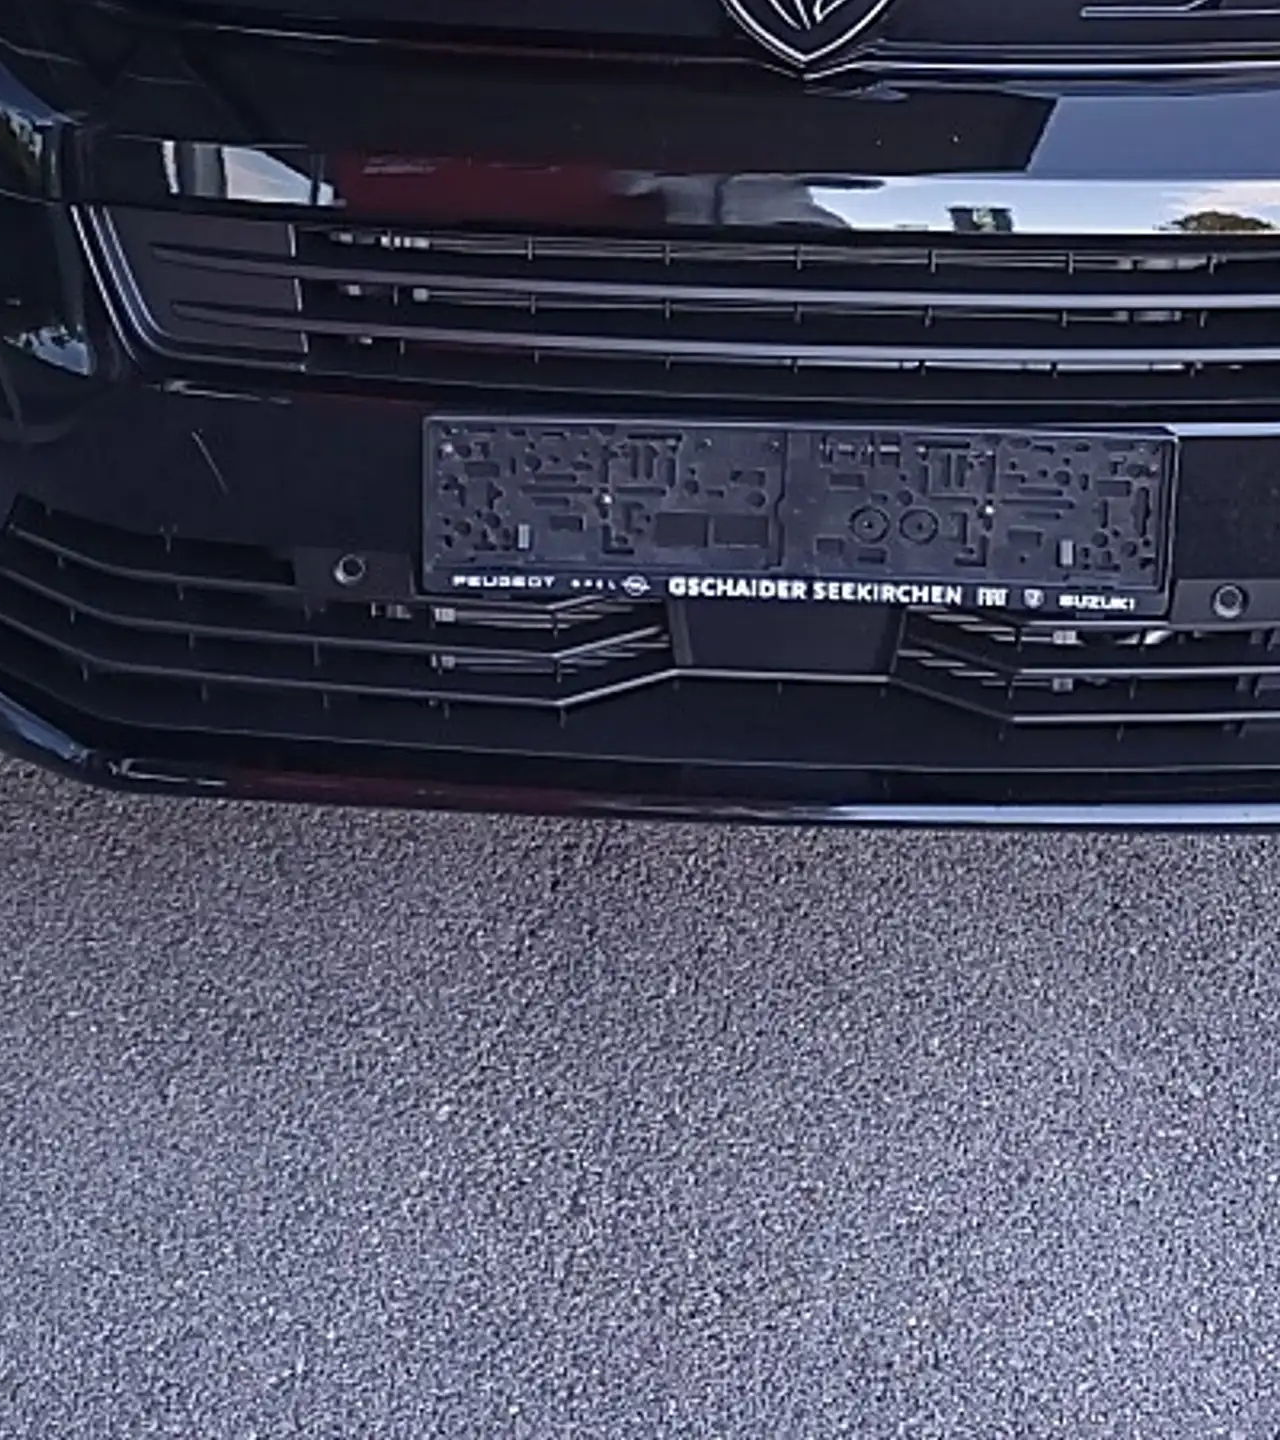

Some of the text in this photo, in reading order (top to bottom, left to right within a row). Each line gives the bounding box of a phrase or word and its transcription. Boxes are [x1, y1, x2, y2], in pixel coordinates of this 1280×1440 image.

[452, 575, 555, 588] PEUGEOT
[669, 576, 807, 600] GSCHAIDER
[812, 582, 962, 605] SEEKIRCHEN
[1059, 594, 1135, 611] SUZUKI
